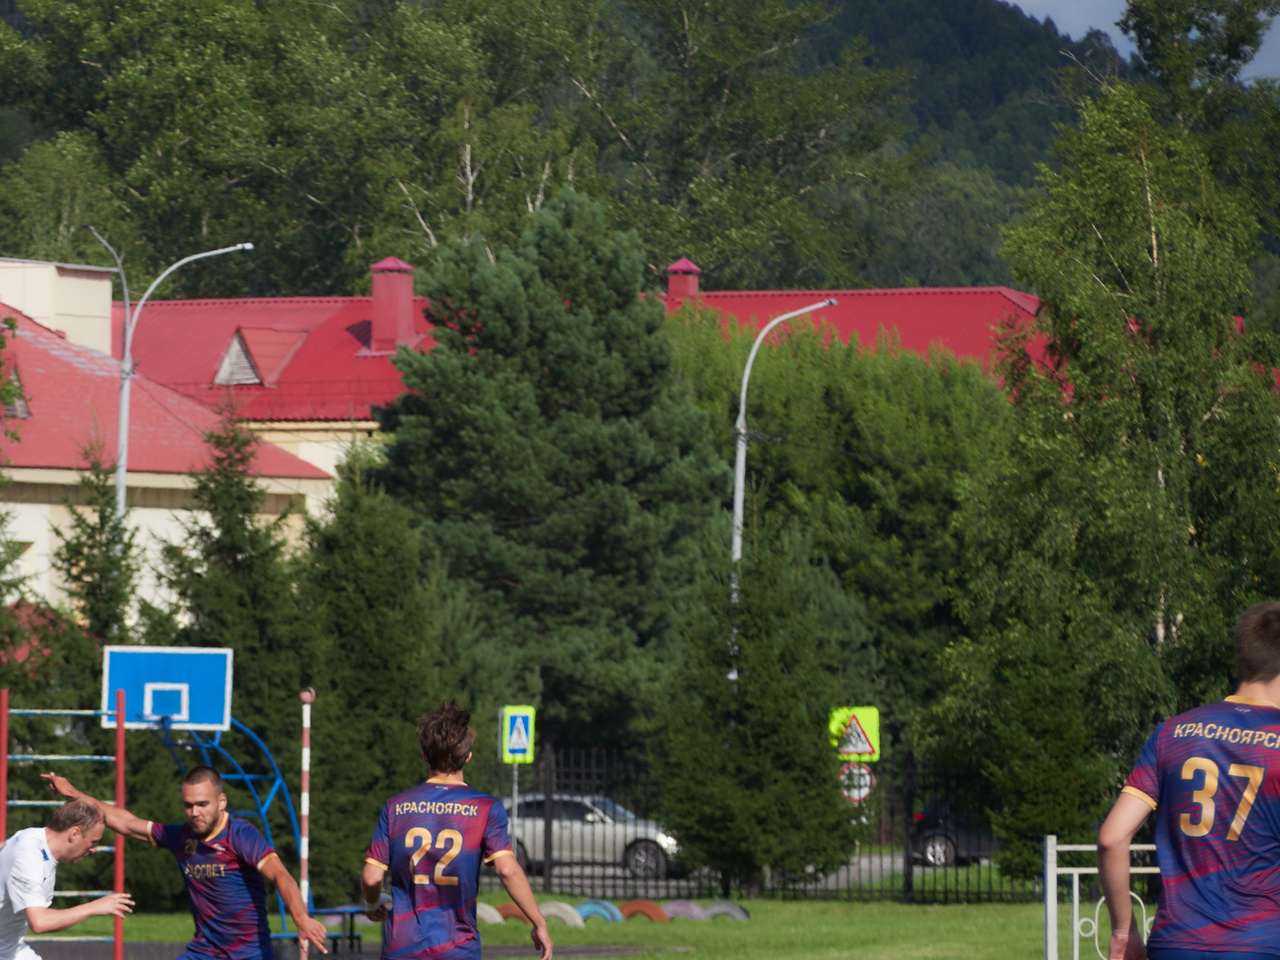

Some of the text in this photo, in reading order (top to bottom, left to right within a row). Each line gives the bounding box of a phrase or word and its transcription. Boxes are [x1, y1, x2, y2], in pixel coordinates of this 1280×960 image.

[395, 801, 479, 816] КРАСНОЯРСК
[1179, 756, 1265, 841] 37
[404, 827, 463, 886] 22
